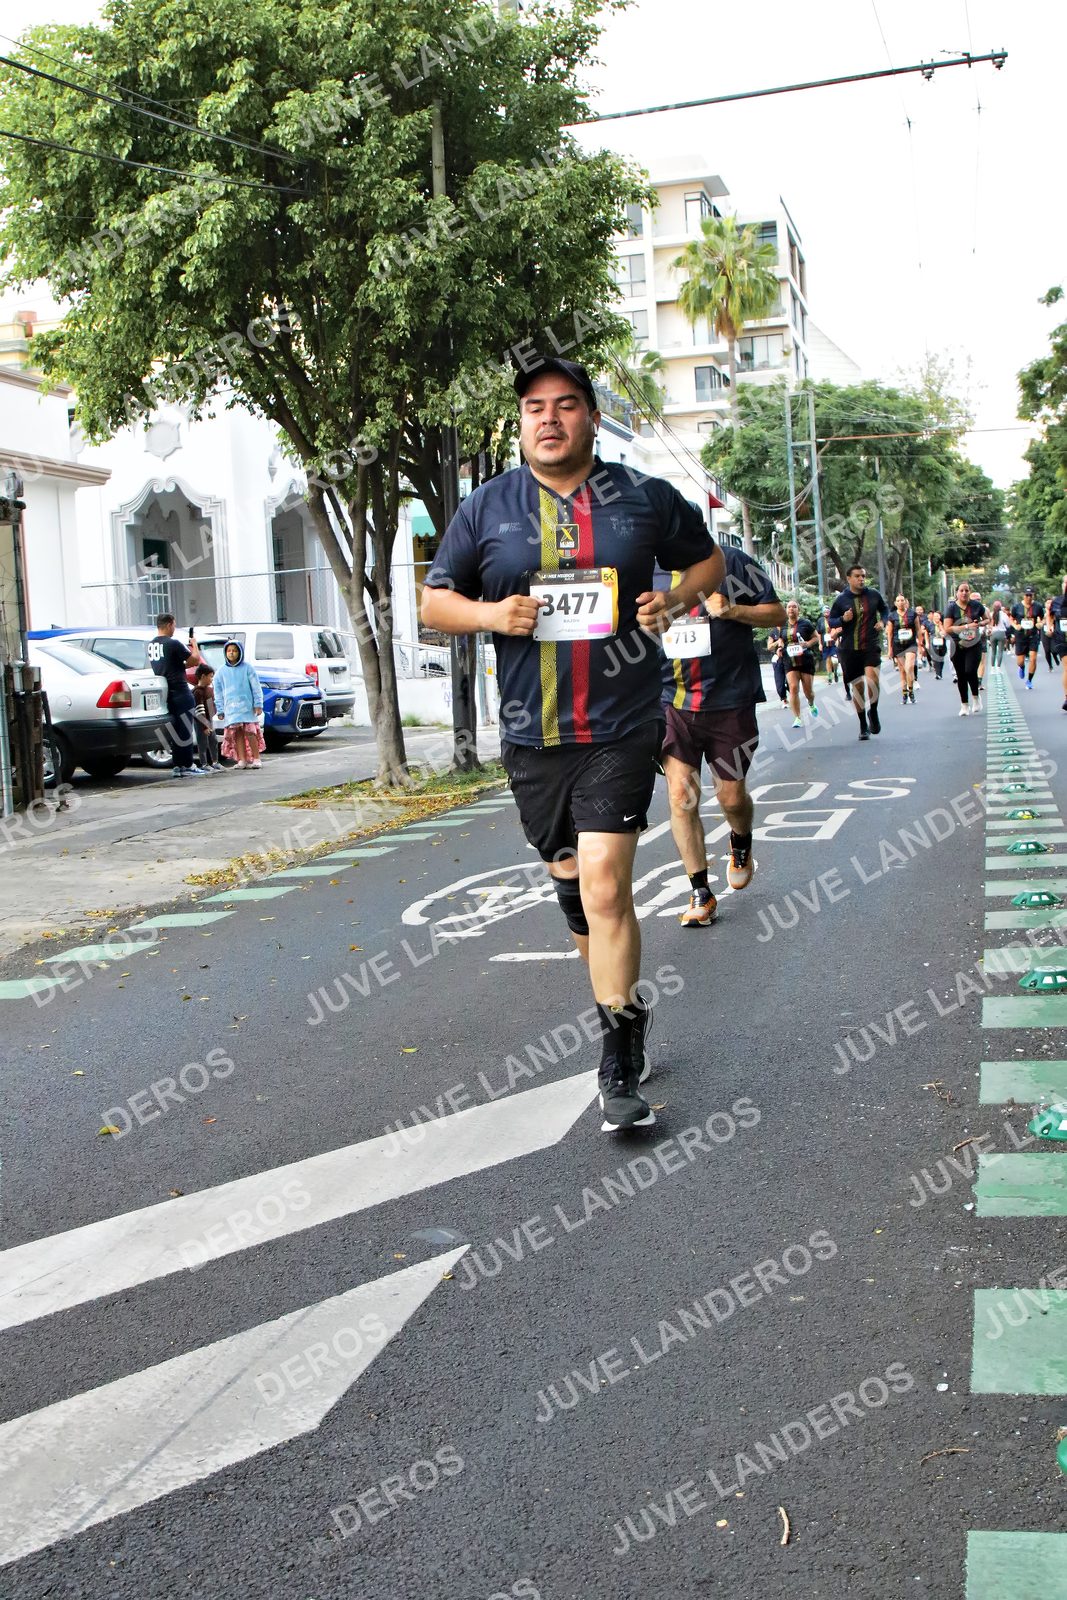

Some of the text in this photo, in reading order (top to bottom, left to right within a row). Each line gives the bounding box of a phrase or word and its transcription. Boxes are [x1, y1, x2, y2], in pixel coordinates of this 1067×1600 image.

[603, 573, 614, 581] 5K
[542, 591, 600, 617] 3477
[673, 630, 698, 645] 713
